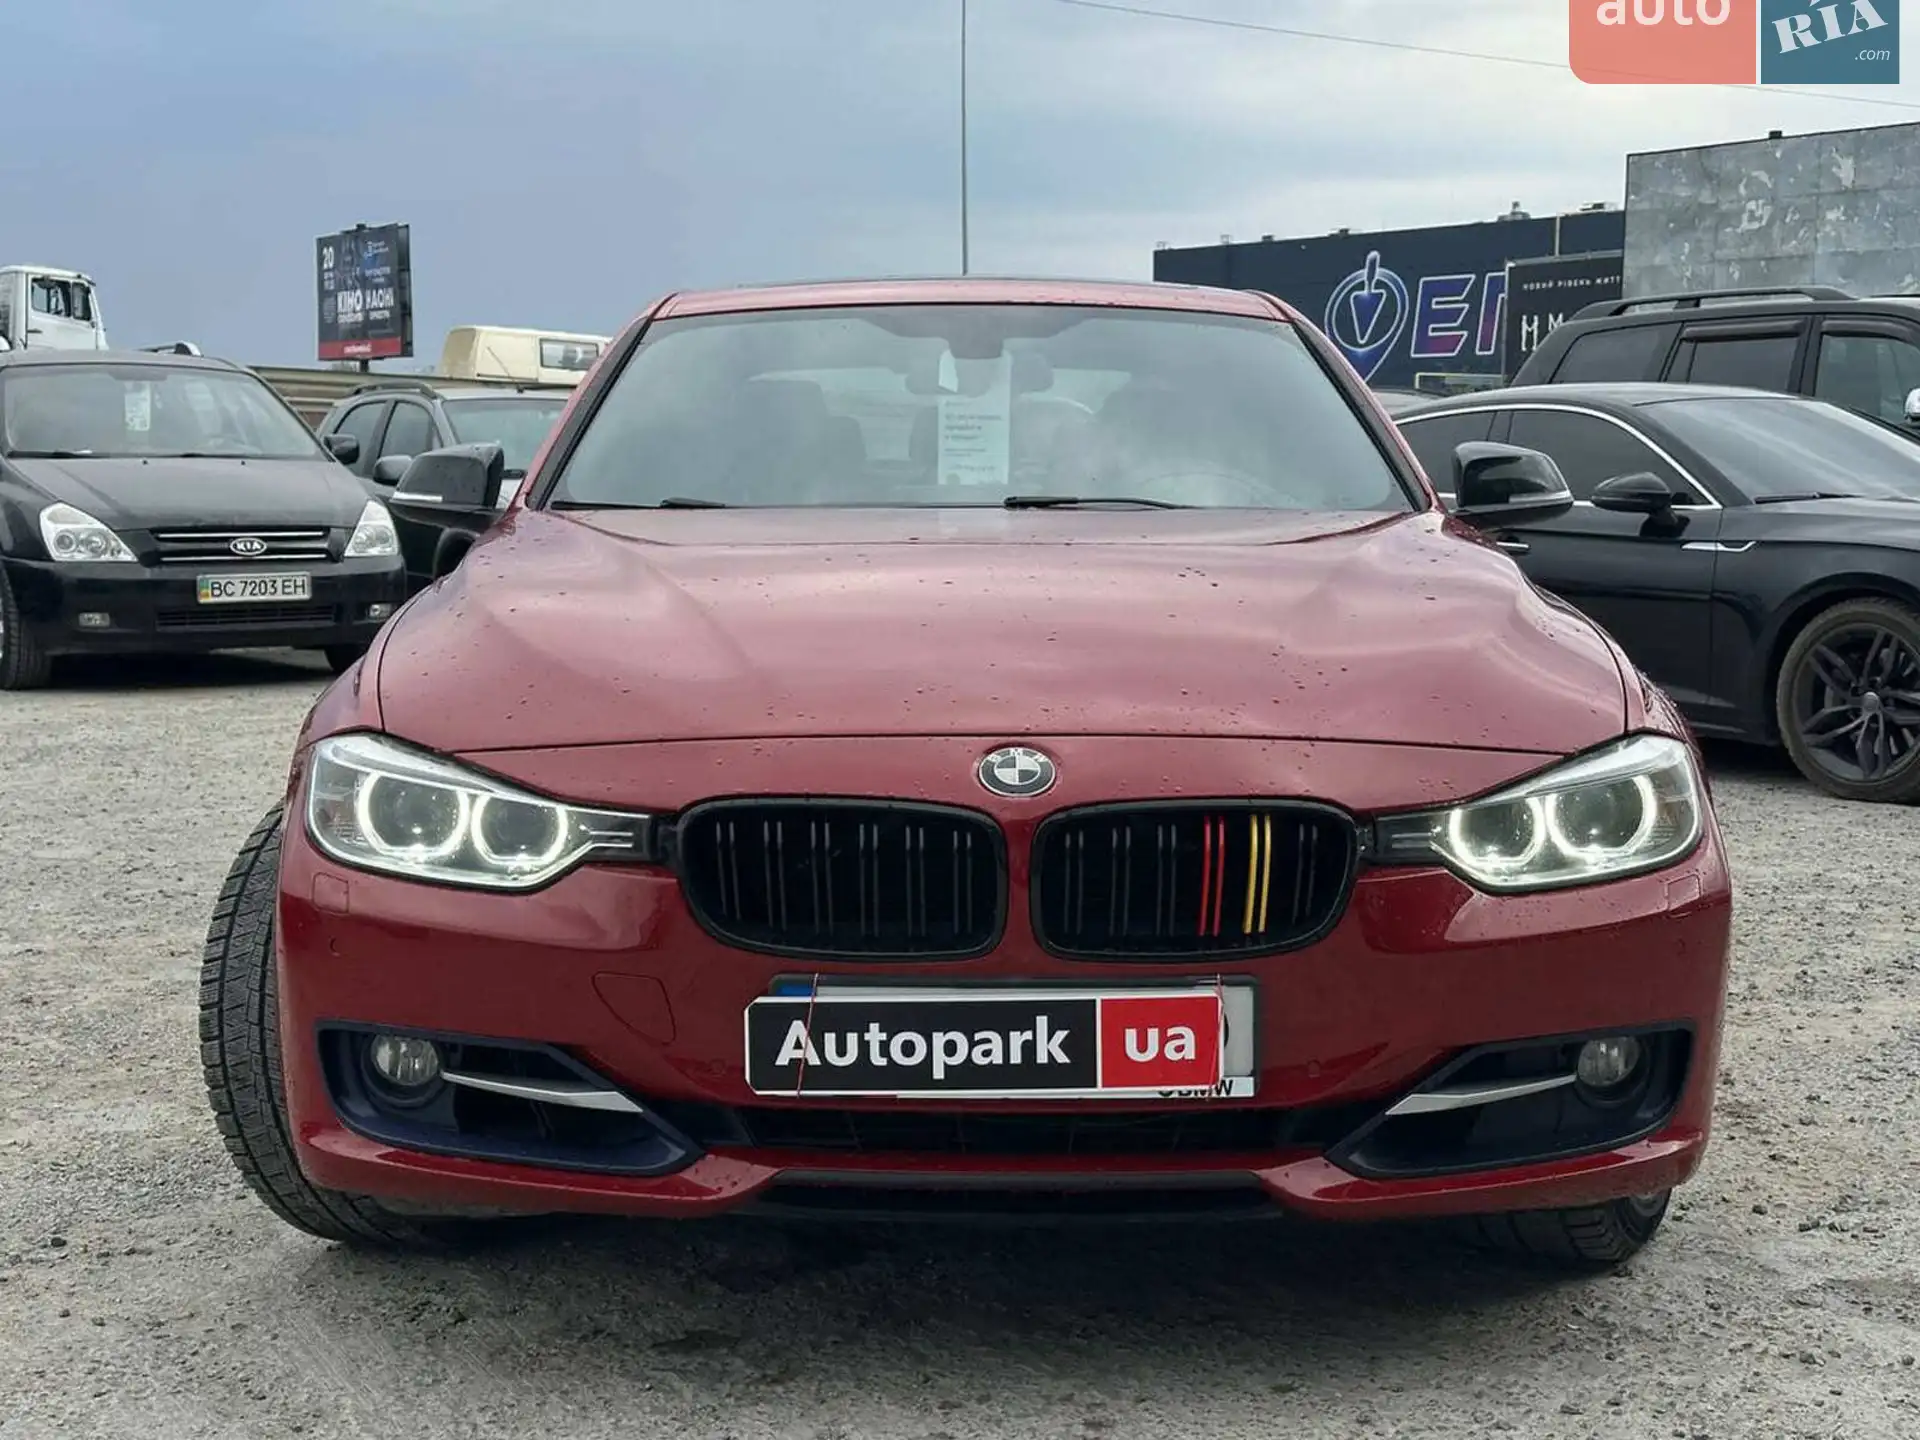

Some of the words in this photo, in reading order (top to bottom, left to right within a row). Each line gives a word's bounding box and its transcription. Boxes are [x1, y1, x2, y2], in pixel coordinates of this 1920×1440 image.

[322, 246, 334, 269] 20
[236, 541, 261, 551] KIA
[210, 580, 235, 598] BC
[240, 579, 277, 597] 7203
[281, 577, 306, 596] EH
[774, 1015, 1072, 1080] Autopark
[1123, 1025, 1196, 1063] ua
